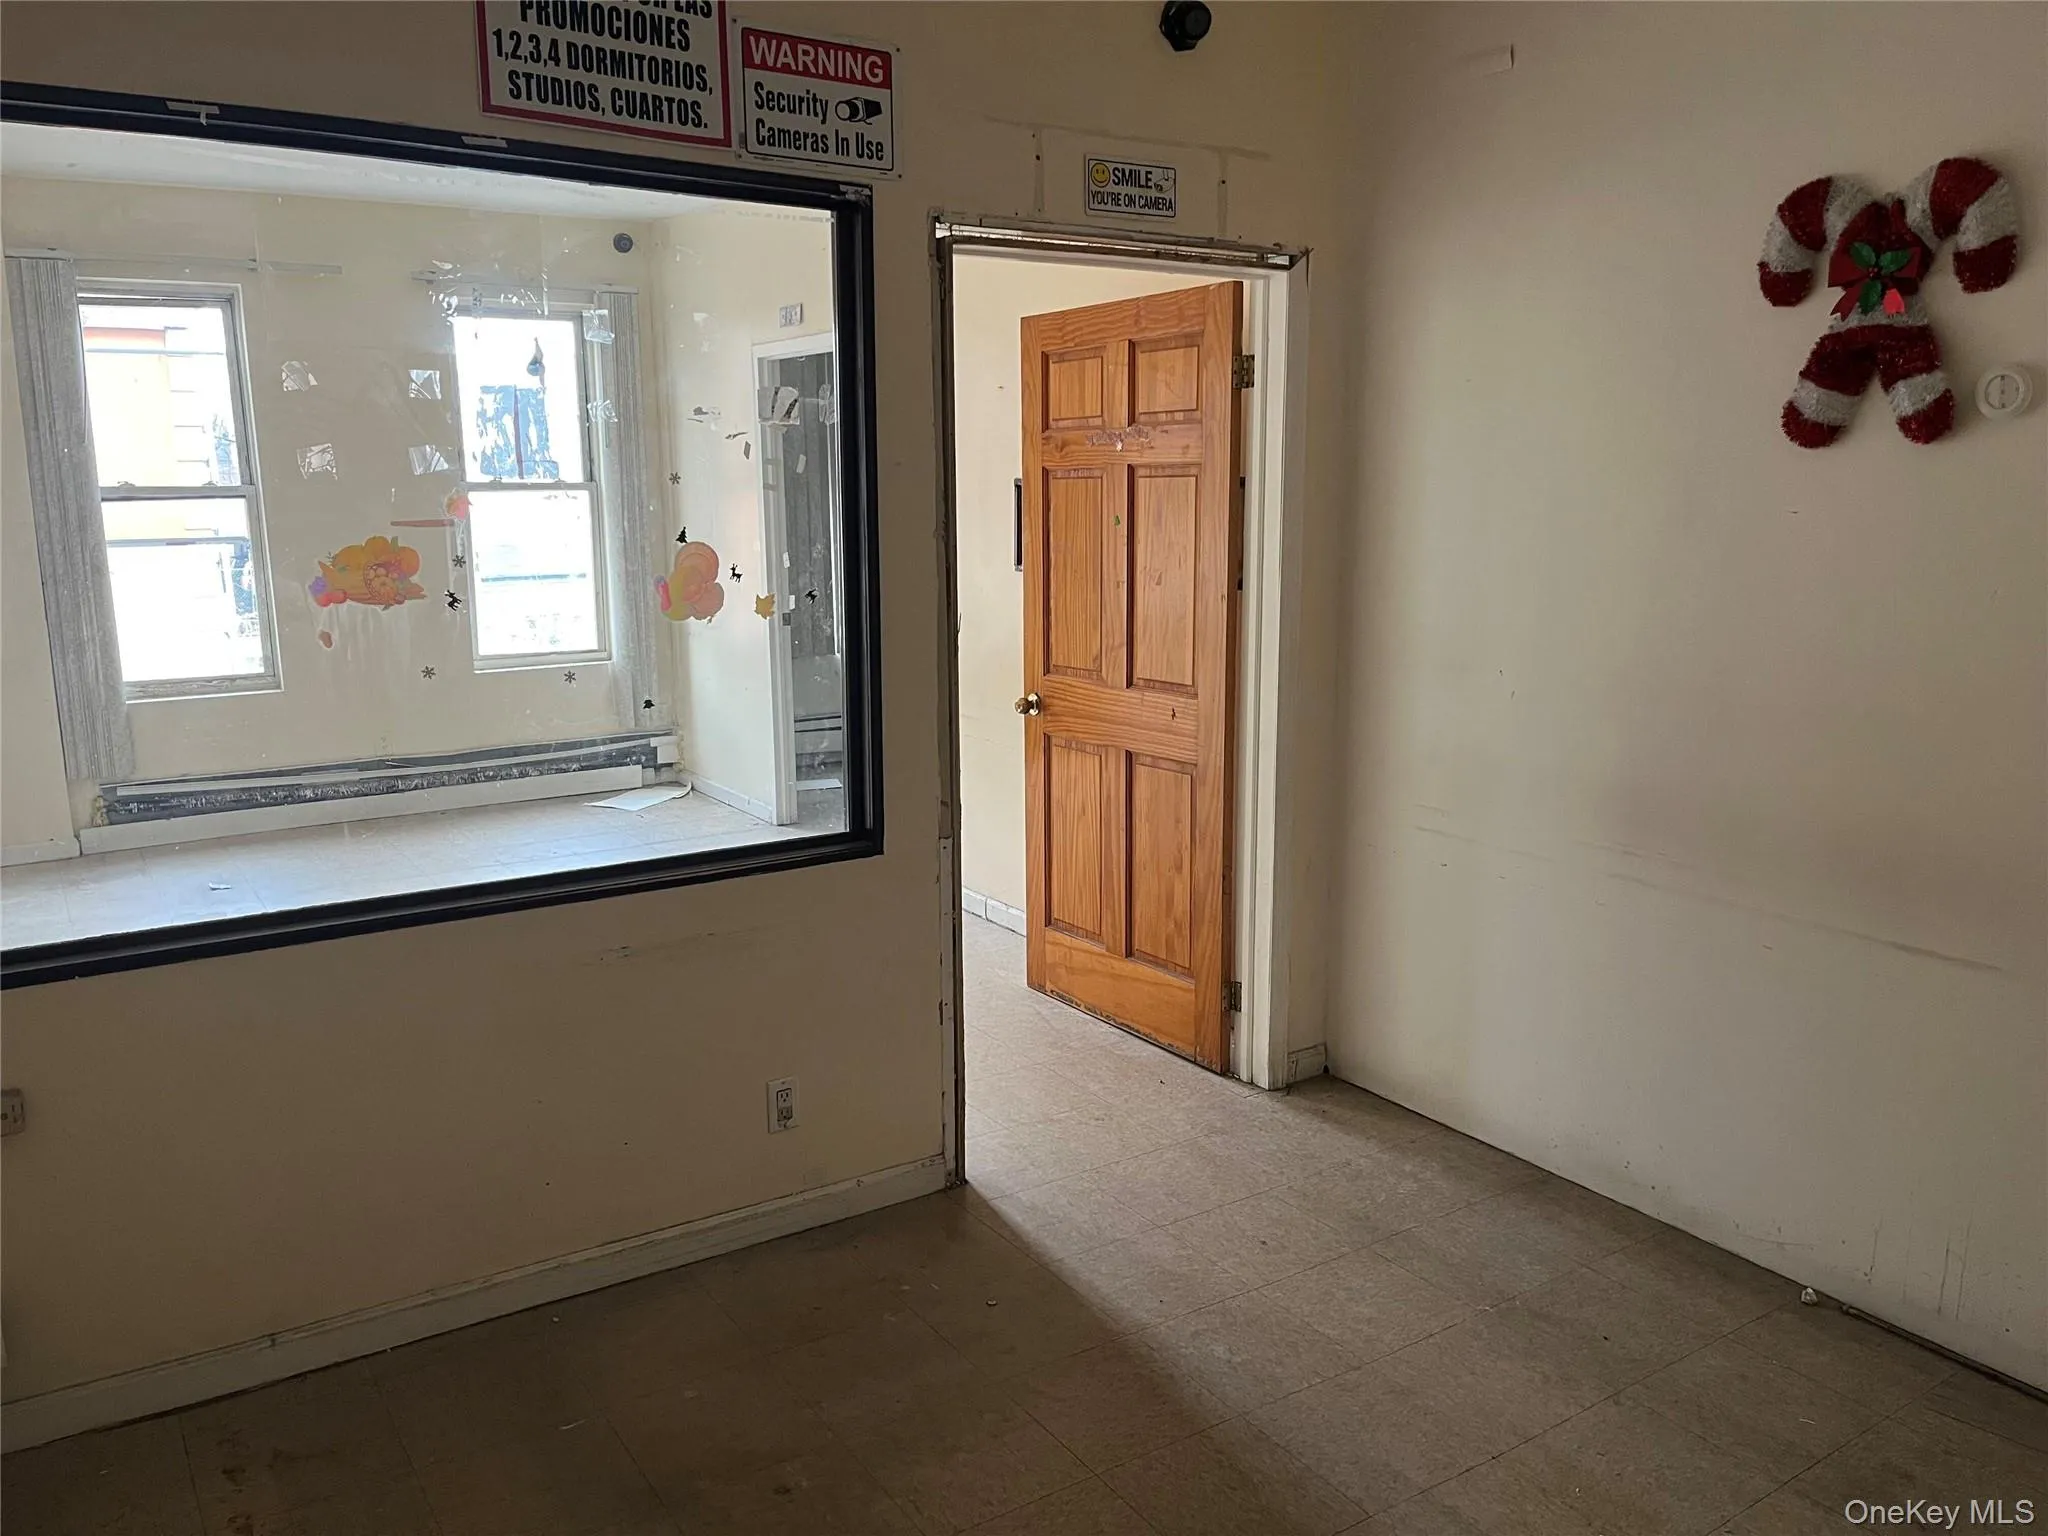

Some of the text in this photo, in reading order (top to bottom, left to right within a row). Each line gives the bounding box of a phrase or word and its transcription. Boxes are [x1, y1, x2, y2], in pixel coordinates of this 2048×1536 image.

[520, 0, 690, 51] PROMOCIONES
[492, 28, 713, 95] 1,2,3,4 DORMITORIOS,
[750, 35, 884, 83] WARNING
[508, 70, 708, 129] STUDIOS, CUARTOS.
[754, 81, 828, 124] Security
[755, 118, 884, 161] Cameras In Use
[1112, 167, 1153, 189] SMILE
[1091, 190, 1173, 212] YOU'RE ON CAMERA
